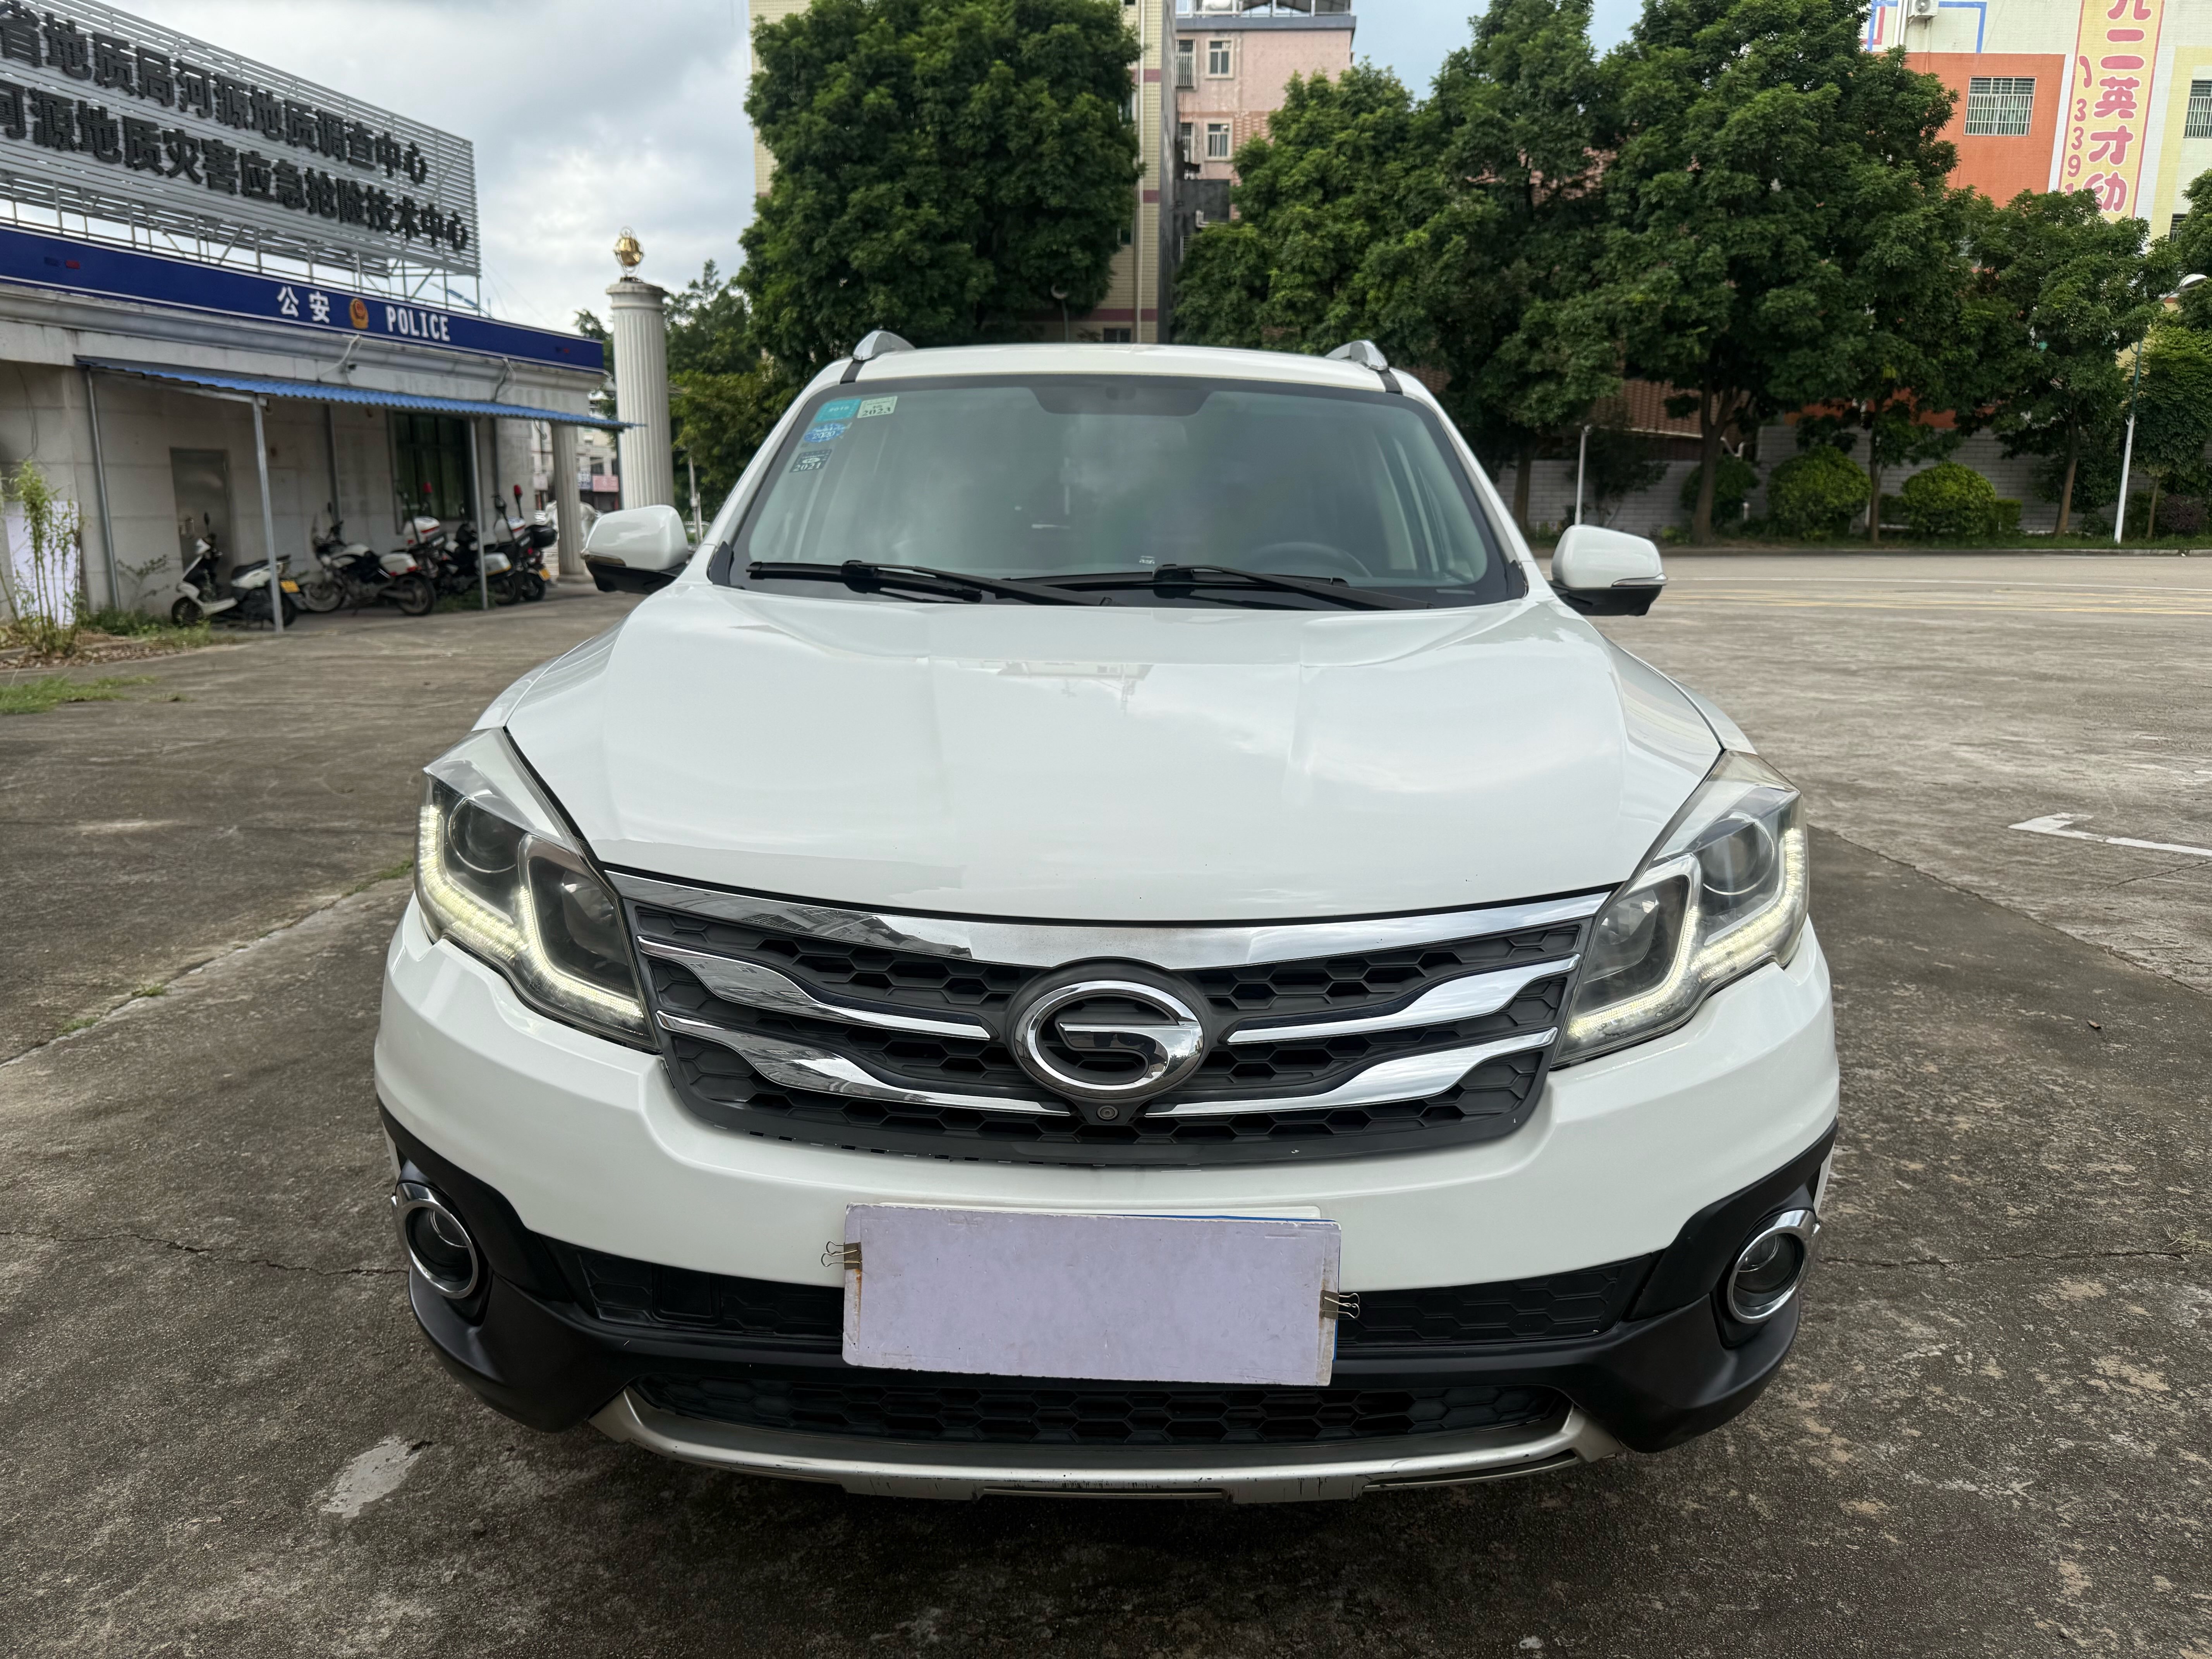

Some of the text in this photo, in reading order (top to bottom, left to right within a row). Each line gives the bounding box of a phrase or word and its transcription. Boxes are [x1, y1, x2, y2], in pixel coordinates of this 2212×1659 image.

[276, 286, 450, 342] 公安 POLICE
[862, 407, 891, 416] 2023
[812, 431, 836, 439] 2020
[793, 462, 821, 472] 2021
